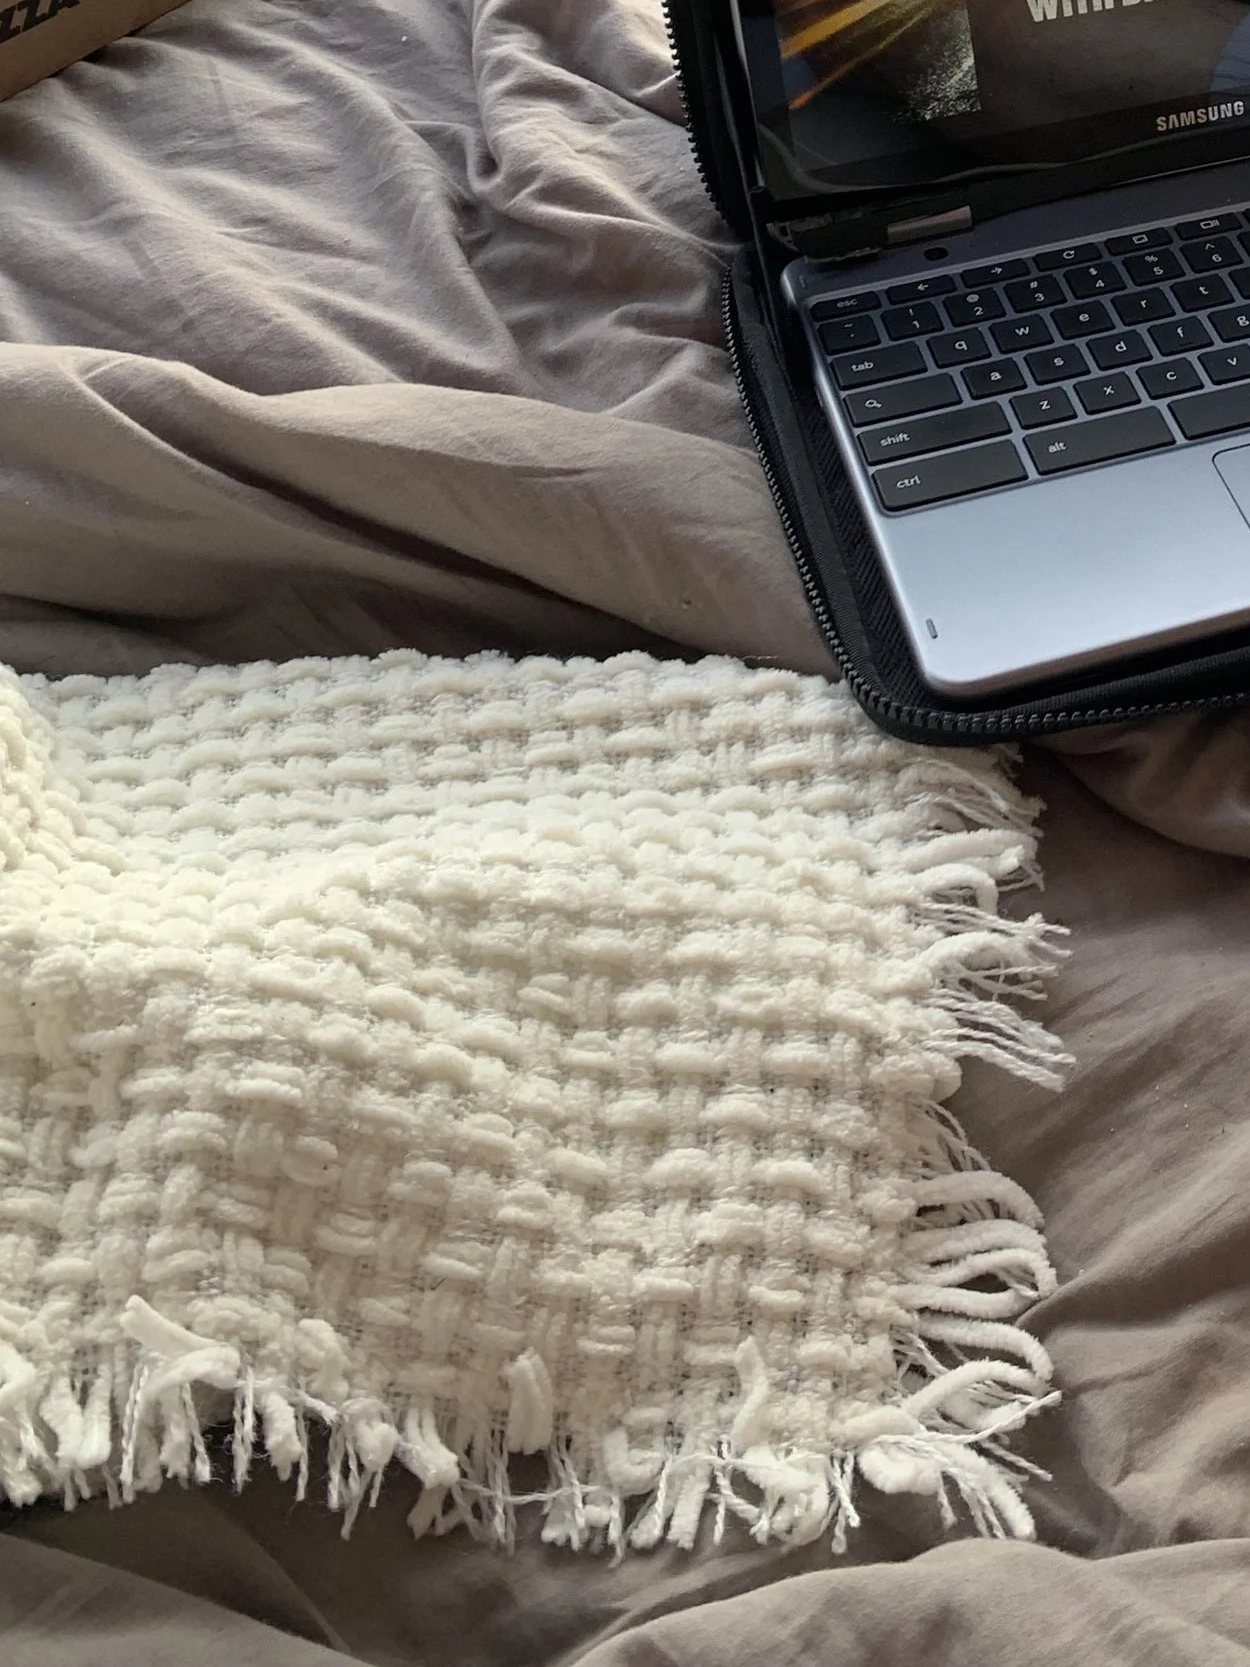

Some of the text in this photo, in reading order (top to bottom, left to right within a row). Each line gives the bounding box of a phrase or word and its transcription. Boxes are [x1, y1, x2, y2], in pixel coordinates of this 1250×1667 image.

[1155, 100, 1246, 133] SAMSUNG
[1211, 253, 1222, 263] 6
[1153, 266, 1164, 276] 5
[1095, 279, 1105, 288] 4
[1198, 286, 1209, 295] t
[1034, 292, 1045, 302] 3
[836, 297, 858, 308] esc
[1140, 299, 1147, 308] r
[973, 306, 984, 316] 2
[1078, 313, 1090, 322] e
[1236, 315, 1250, 327] g
[1014, 326, 1030, 336] w
[1176, 326, 1184, 338] f
[954, 340, 968, 351] q
[1115, 340, 1127, 352] d
[851, 360, 874, 372] tab
[1053, 357, 1064, 366] s
[1227, 357, 1237, 366] v
[990, 371, 1002, 381] a
[1166, 371, 1177, 381] c
[1103, 385, 1115, 396] x
[1039, 400, 1051, 410] z
[880, 432, 910, 447] shift
[1048, 442, 1067, 453] alt
[896, 475, 921, 489] ctrl
